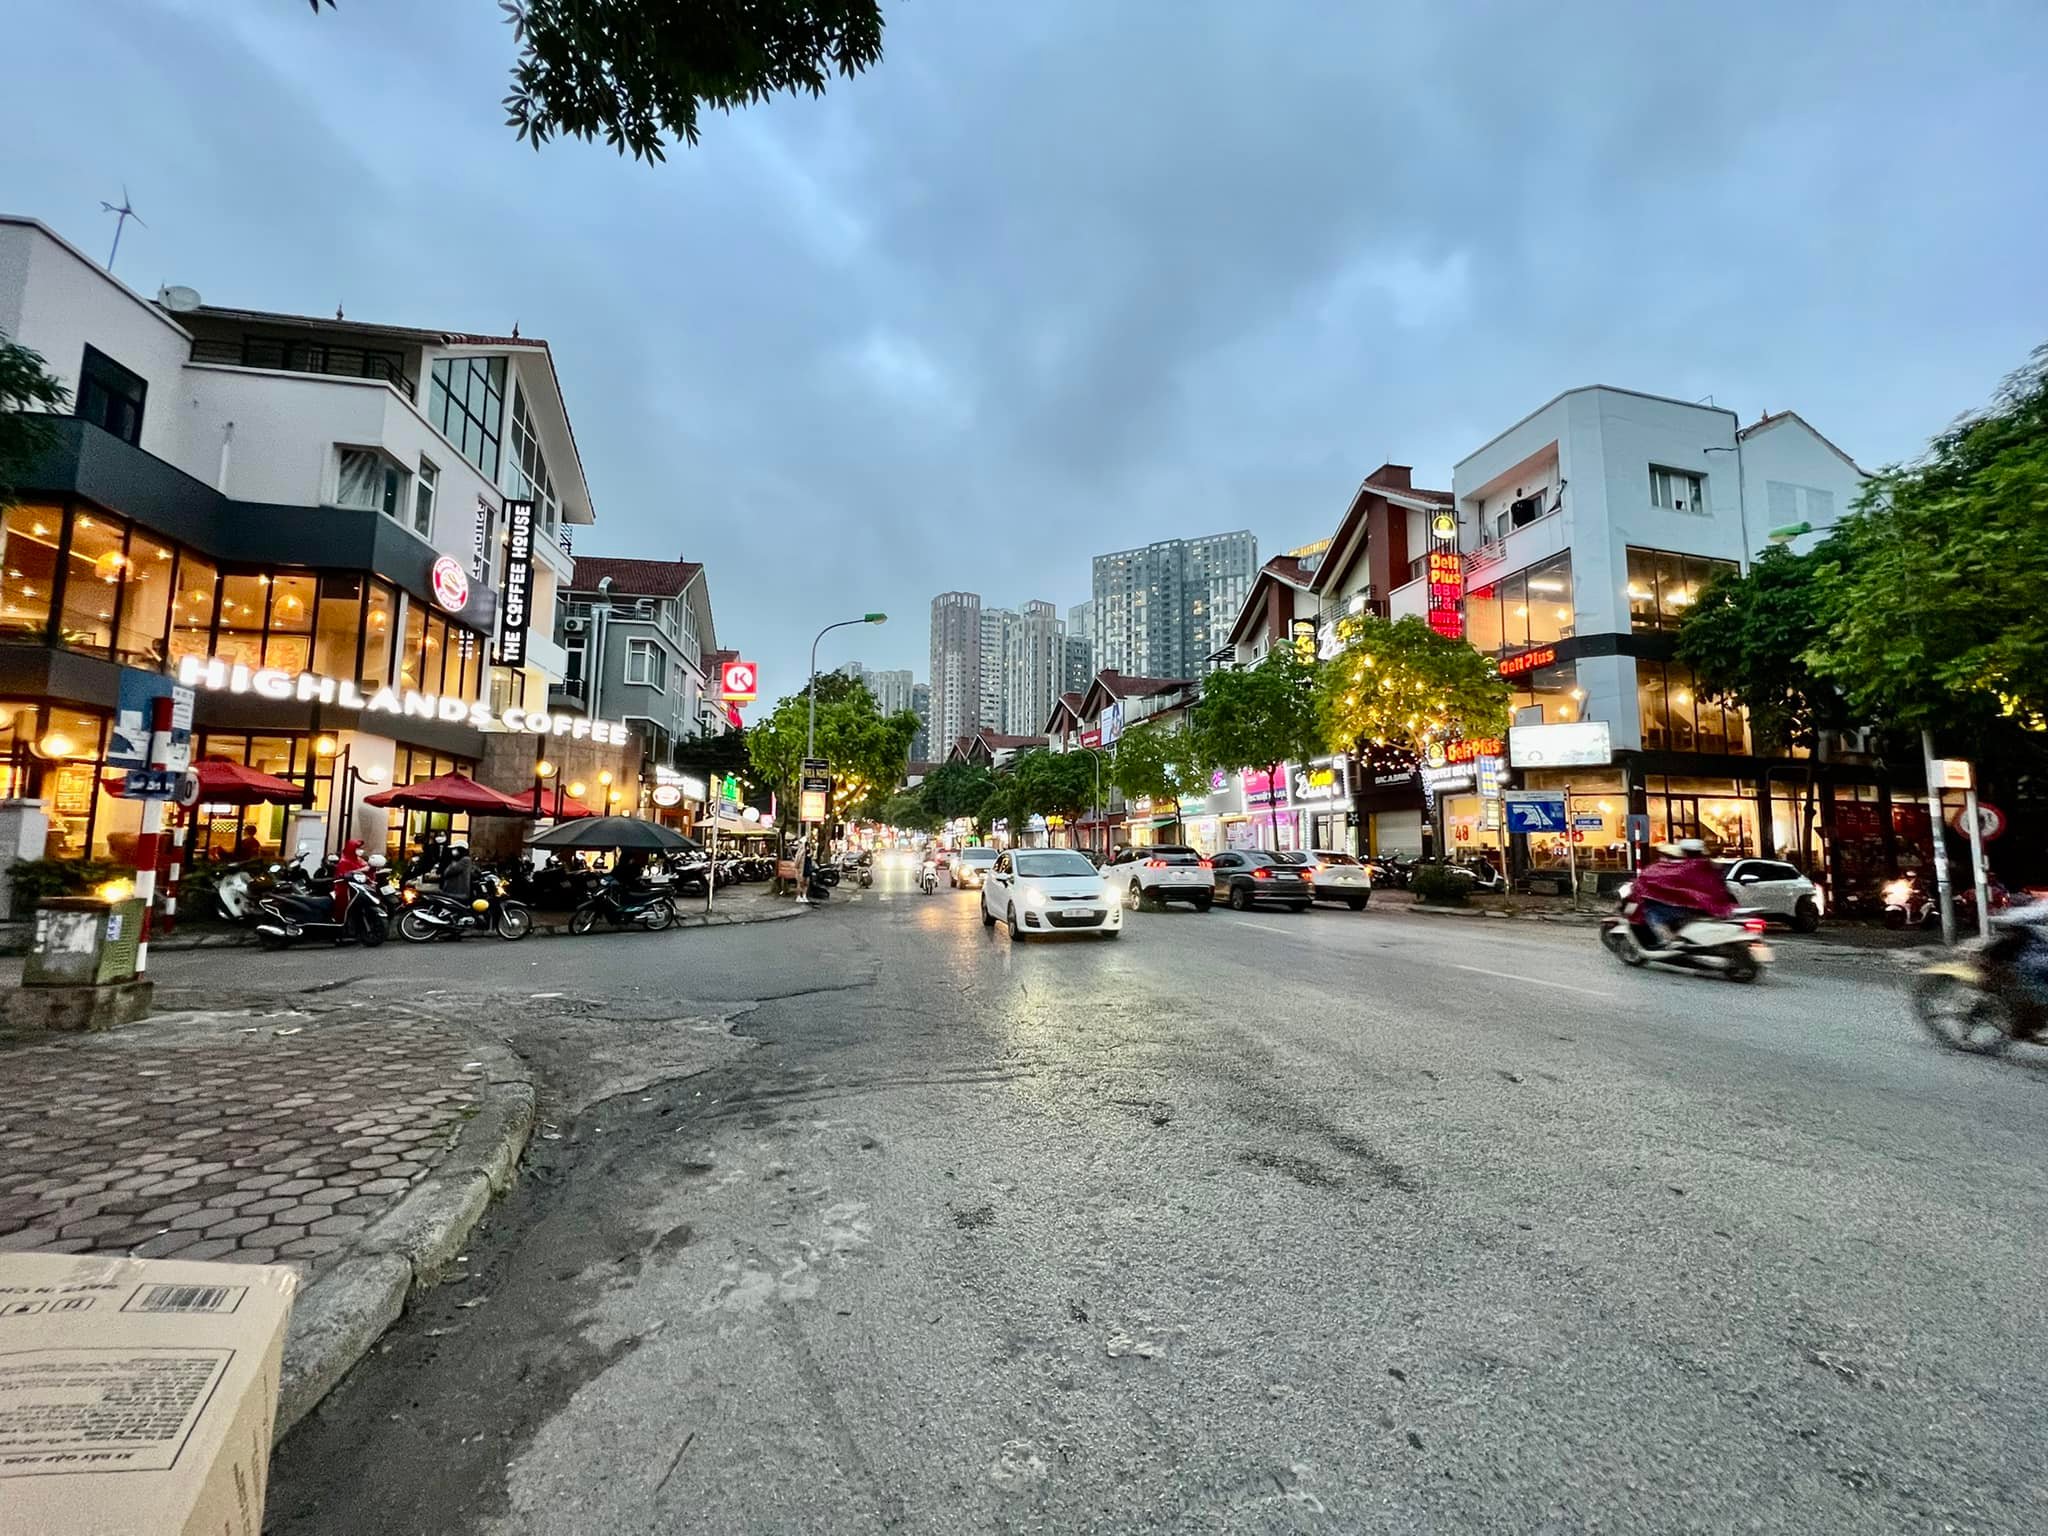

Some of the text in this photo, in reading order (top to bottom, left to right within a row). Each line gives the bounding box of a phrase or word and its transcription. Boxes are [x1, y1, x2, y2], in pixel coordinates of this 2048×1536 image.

[503, 504, 531, 662] THE COFFEE HOUSE
[1431, 569, 1461, 584] Plus
[179, 653, 492, 728] HIGHLANDS
[501, 705, 629, 746] COFFEE
[1455, 825, 1469, 841] 48
